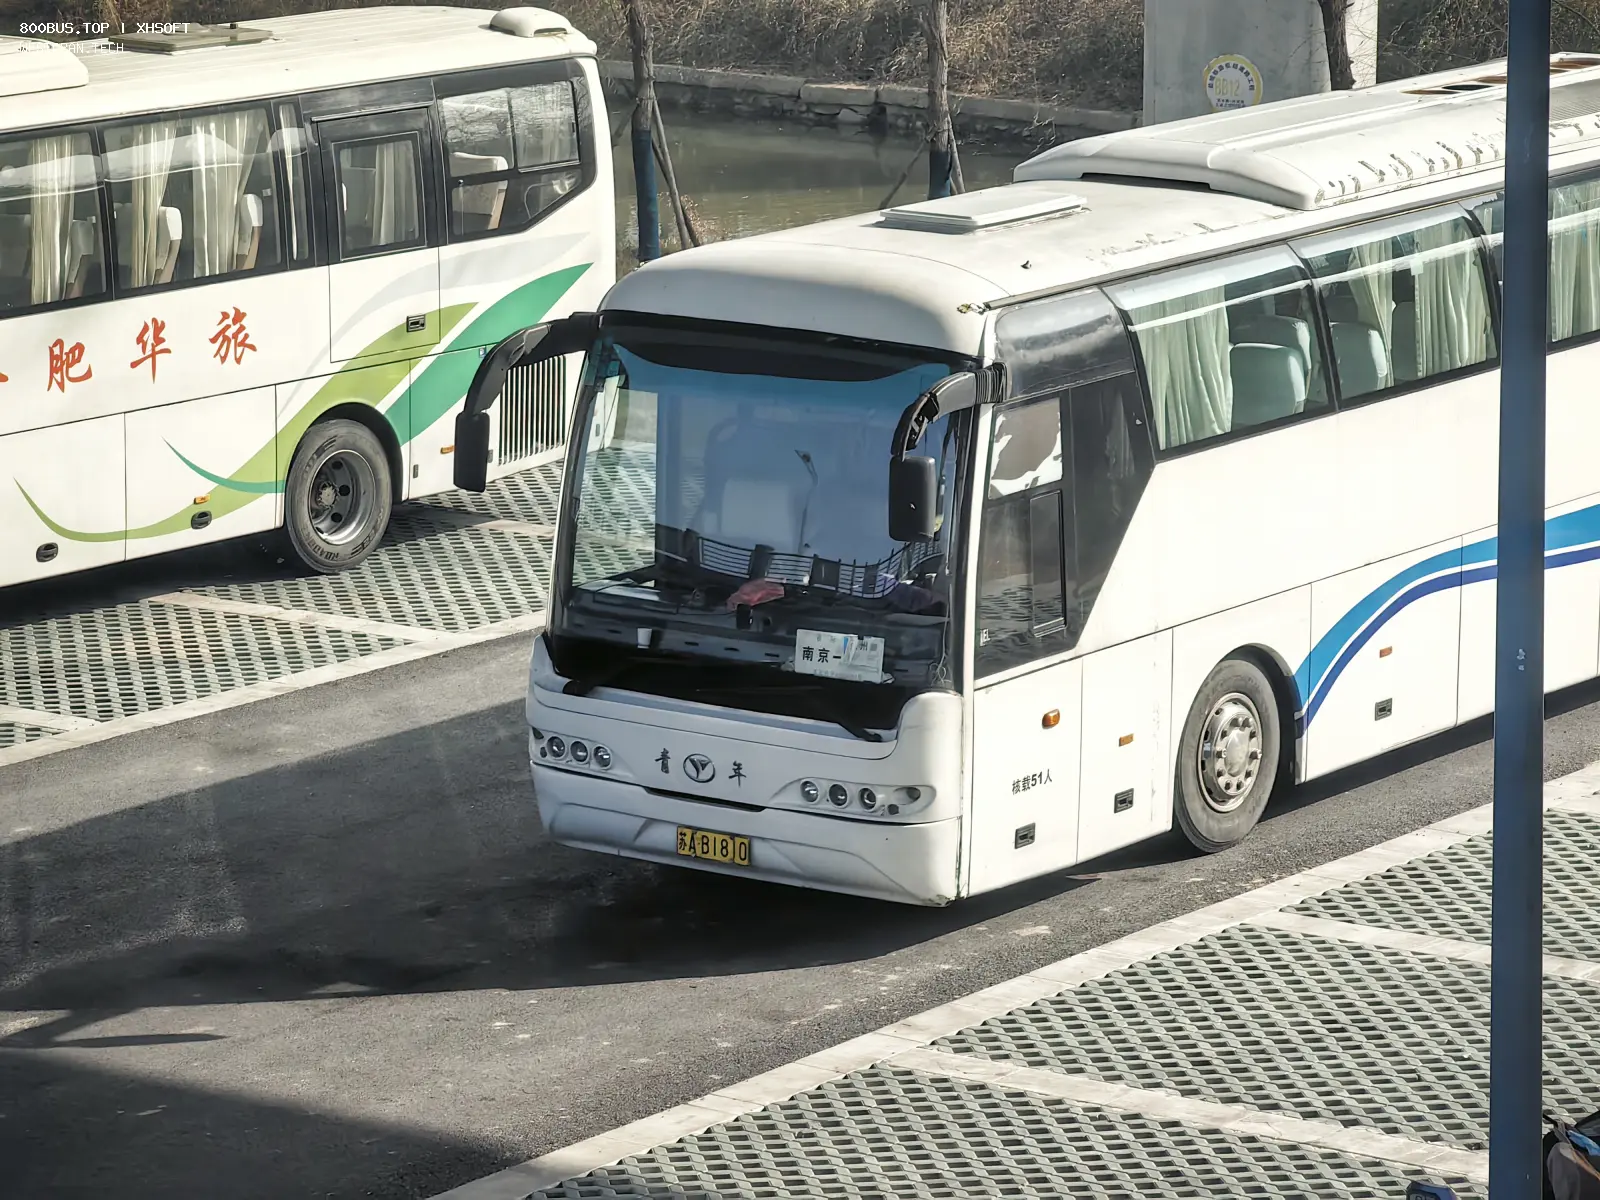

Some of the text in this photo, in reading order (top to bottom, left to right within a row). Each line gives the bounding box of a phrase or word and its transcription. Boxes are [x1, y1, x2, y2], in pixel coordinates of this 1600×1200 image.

[0, 306, 258, 394] 肥华旅
[654, 747, 748, 788] 青 年
[1011, 768, 1052, 796] 核载51人
